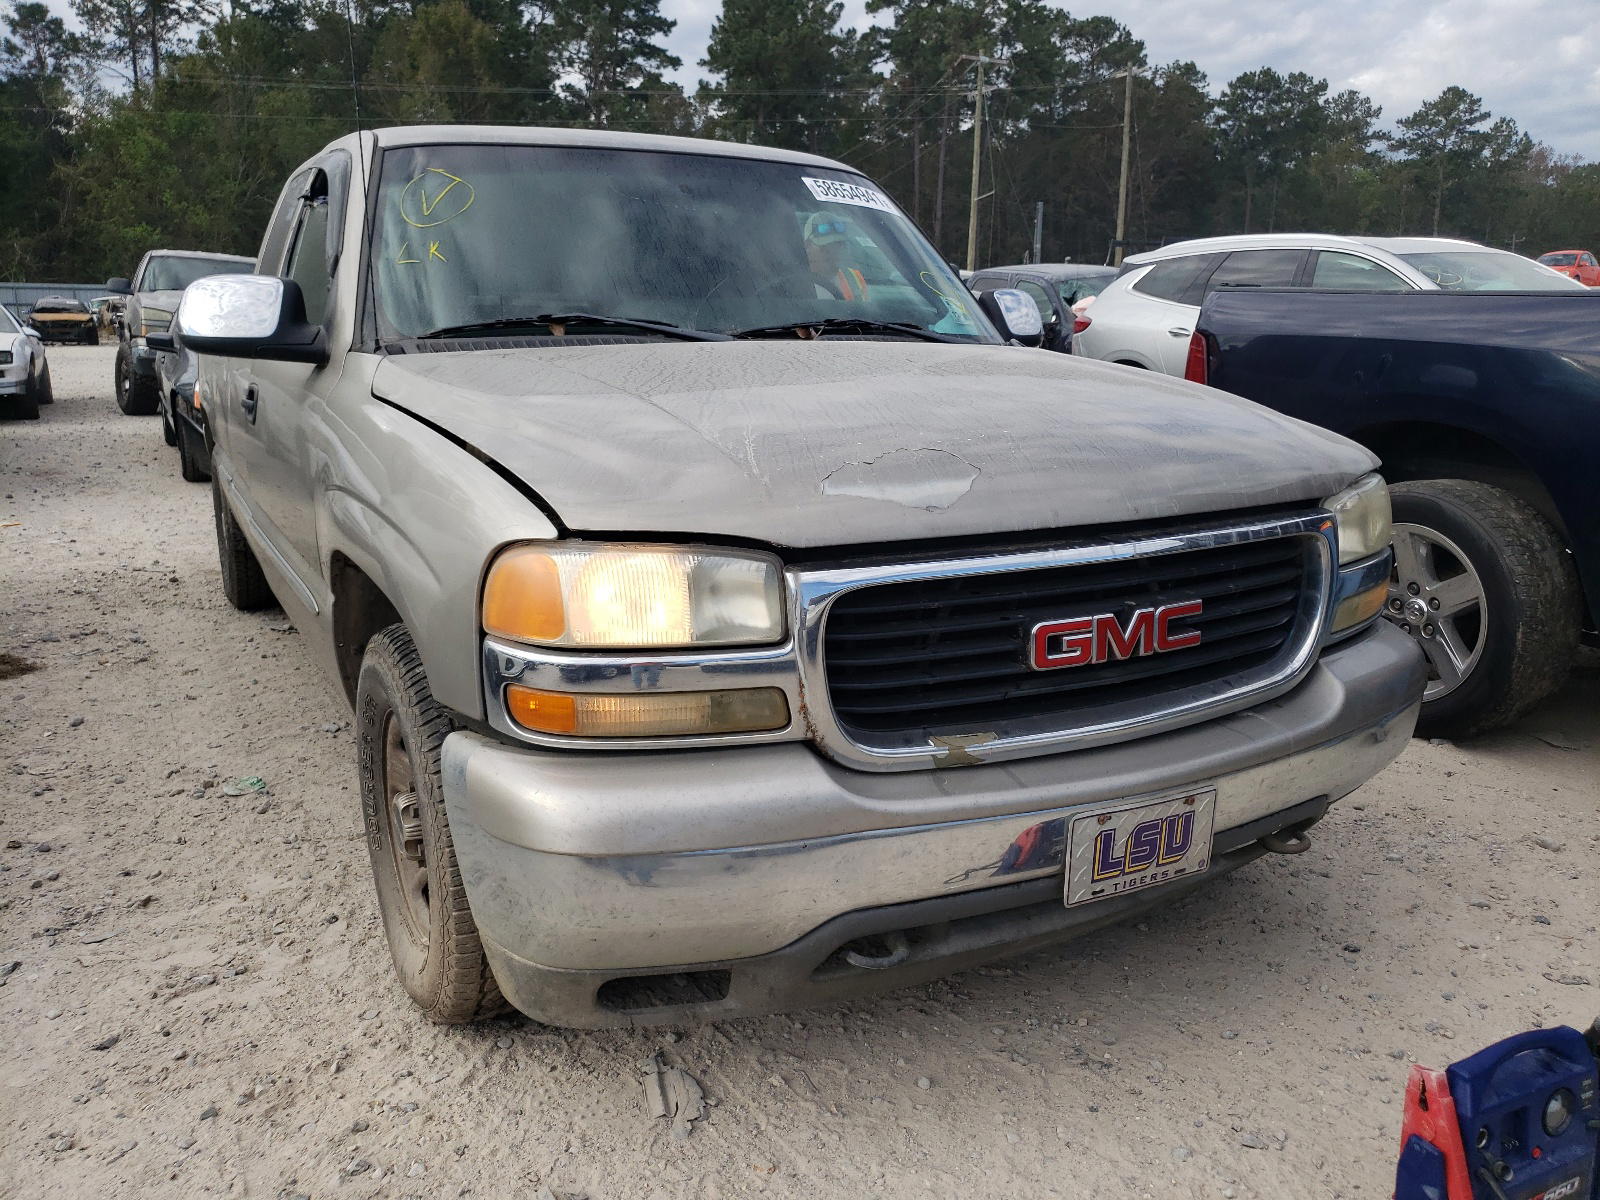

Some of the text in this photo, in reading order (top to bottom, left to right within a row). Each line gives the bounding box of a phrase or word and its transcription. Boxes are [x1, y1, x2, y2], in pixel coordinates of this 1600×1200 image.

[812, 179, 886, 207] 58654941
[1031, 599, 1203, 671] GMC
[1091, 810, 1196, 883] LSU
[1112, 869, 1171, 892] TIGERS
